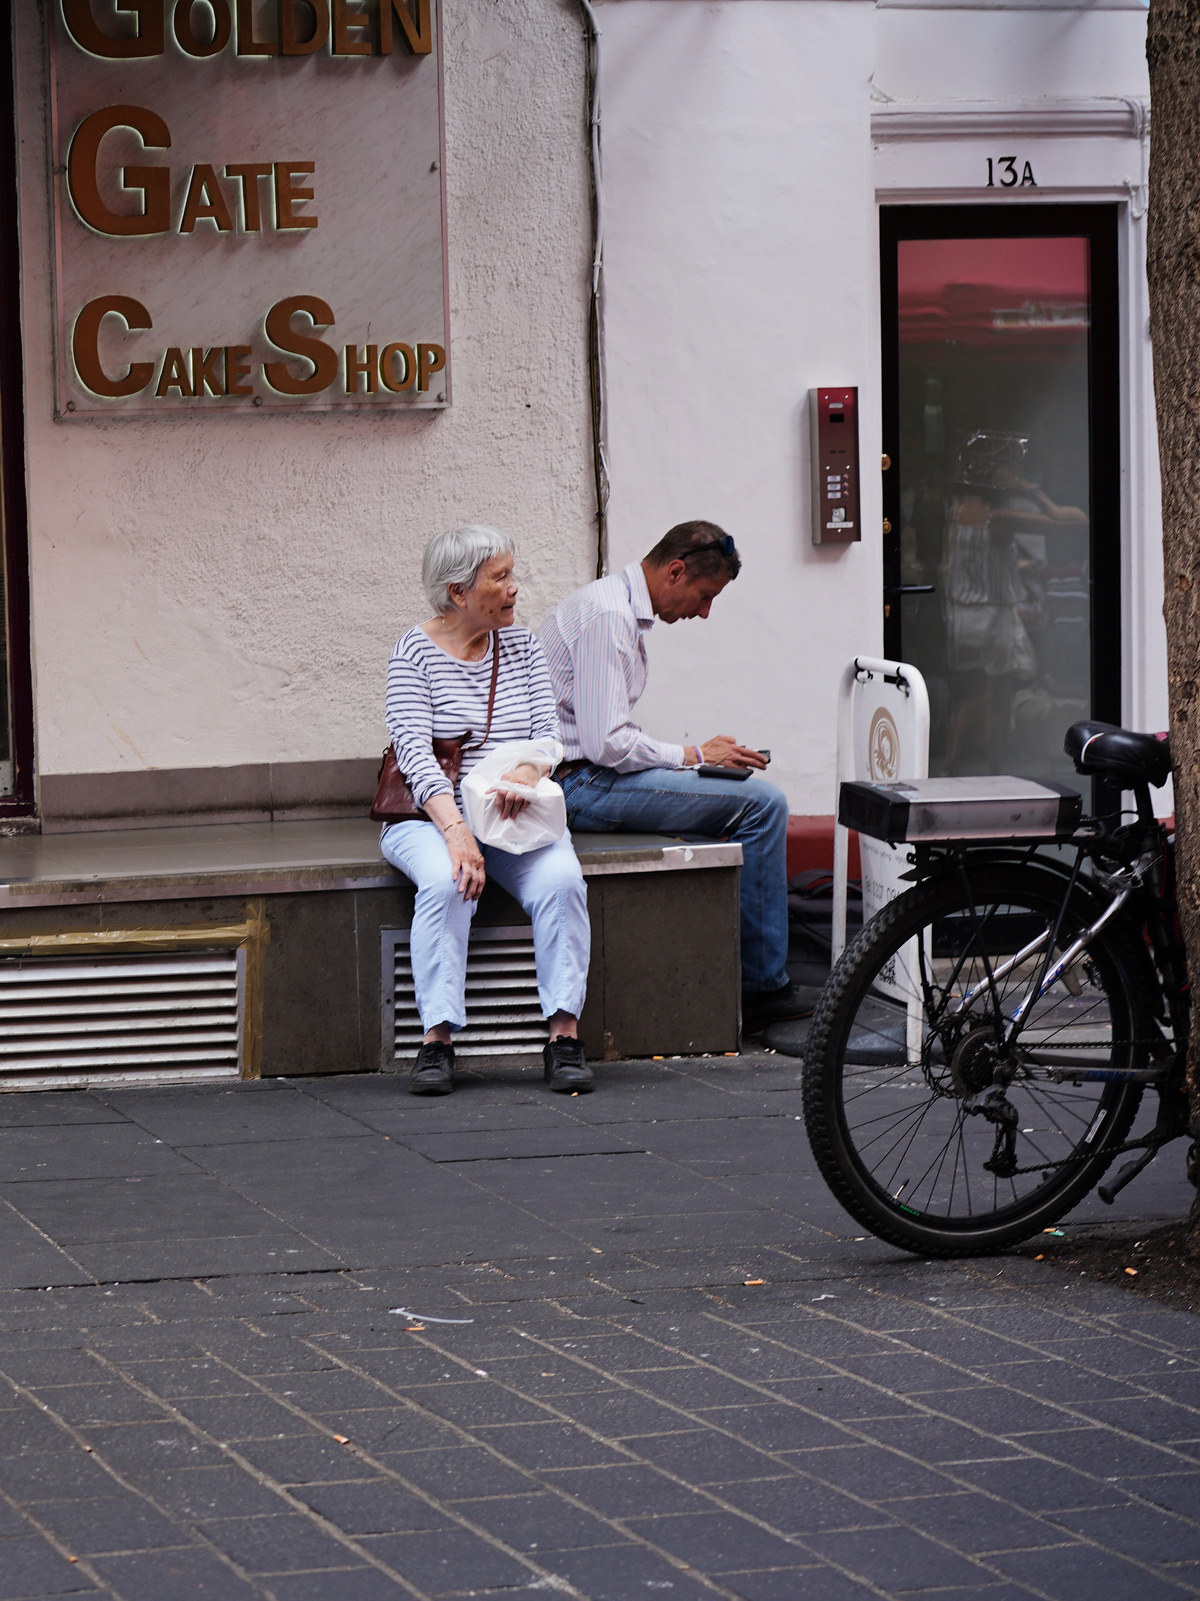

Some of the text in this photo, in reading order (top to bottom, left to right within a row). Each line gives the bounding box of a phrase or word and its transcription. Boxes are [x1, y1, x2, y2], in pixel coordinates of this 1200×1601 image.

[67, 104, 318, 237] GATE
[986, 156, 1038, 187] 13A
[72, 295, 447, 398] CAKE SHOP
